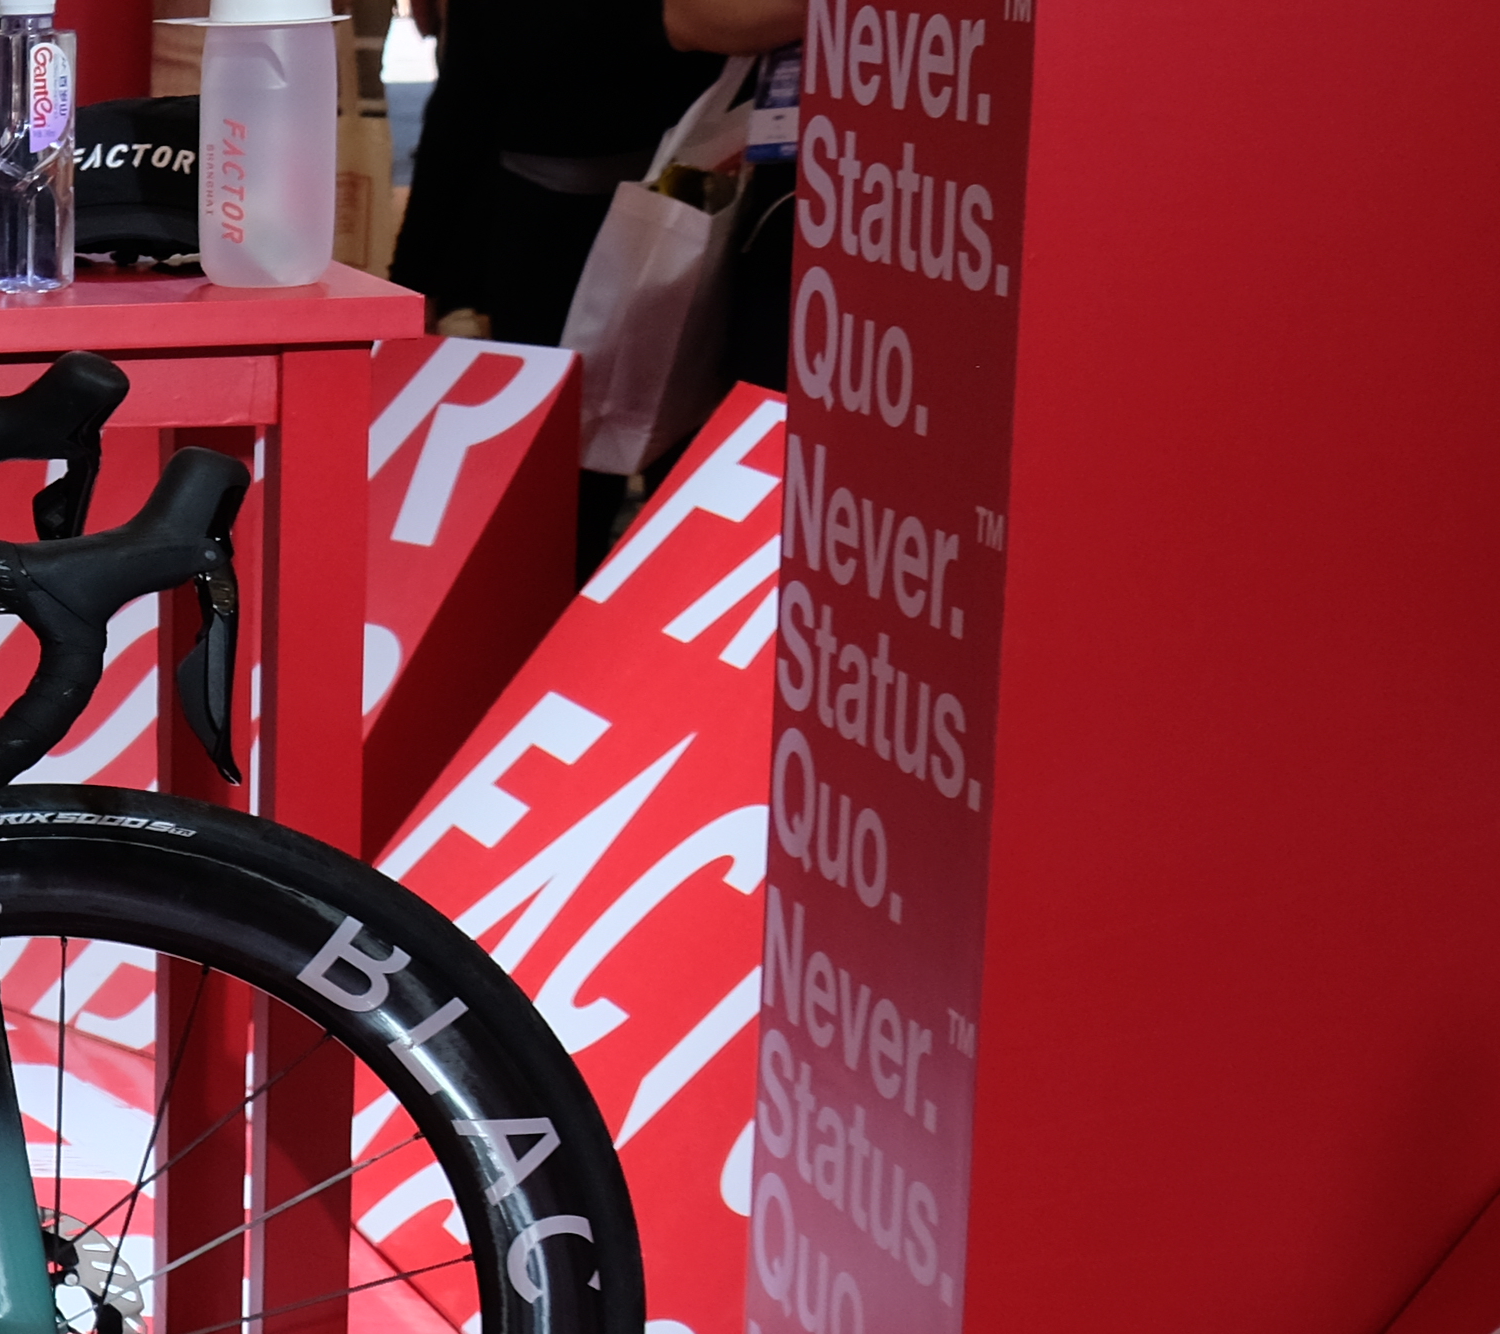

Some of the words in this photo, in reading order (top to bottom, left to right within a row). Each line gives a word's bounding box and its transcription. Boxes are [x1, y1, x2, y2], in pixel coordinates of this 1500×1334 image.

[221, 118, 247, 244] FACTOR
[798, 114, 1010, 297] Status.
[793, 267, 929, 437] Quo.
[782, 434, 964, 639] Never.
[777, 580, 982, 812] Status.
[772, 727, 902, 924] Quo.
[762, 885, 938, 1134] Never.
[757, 1029, 954, 1307] Status.
